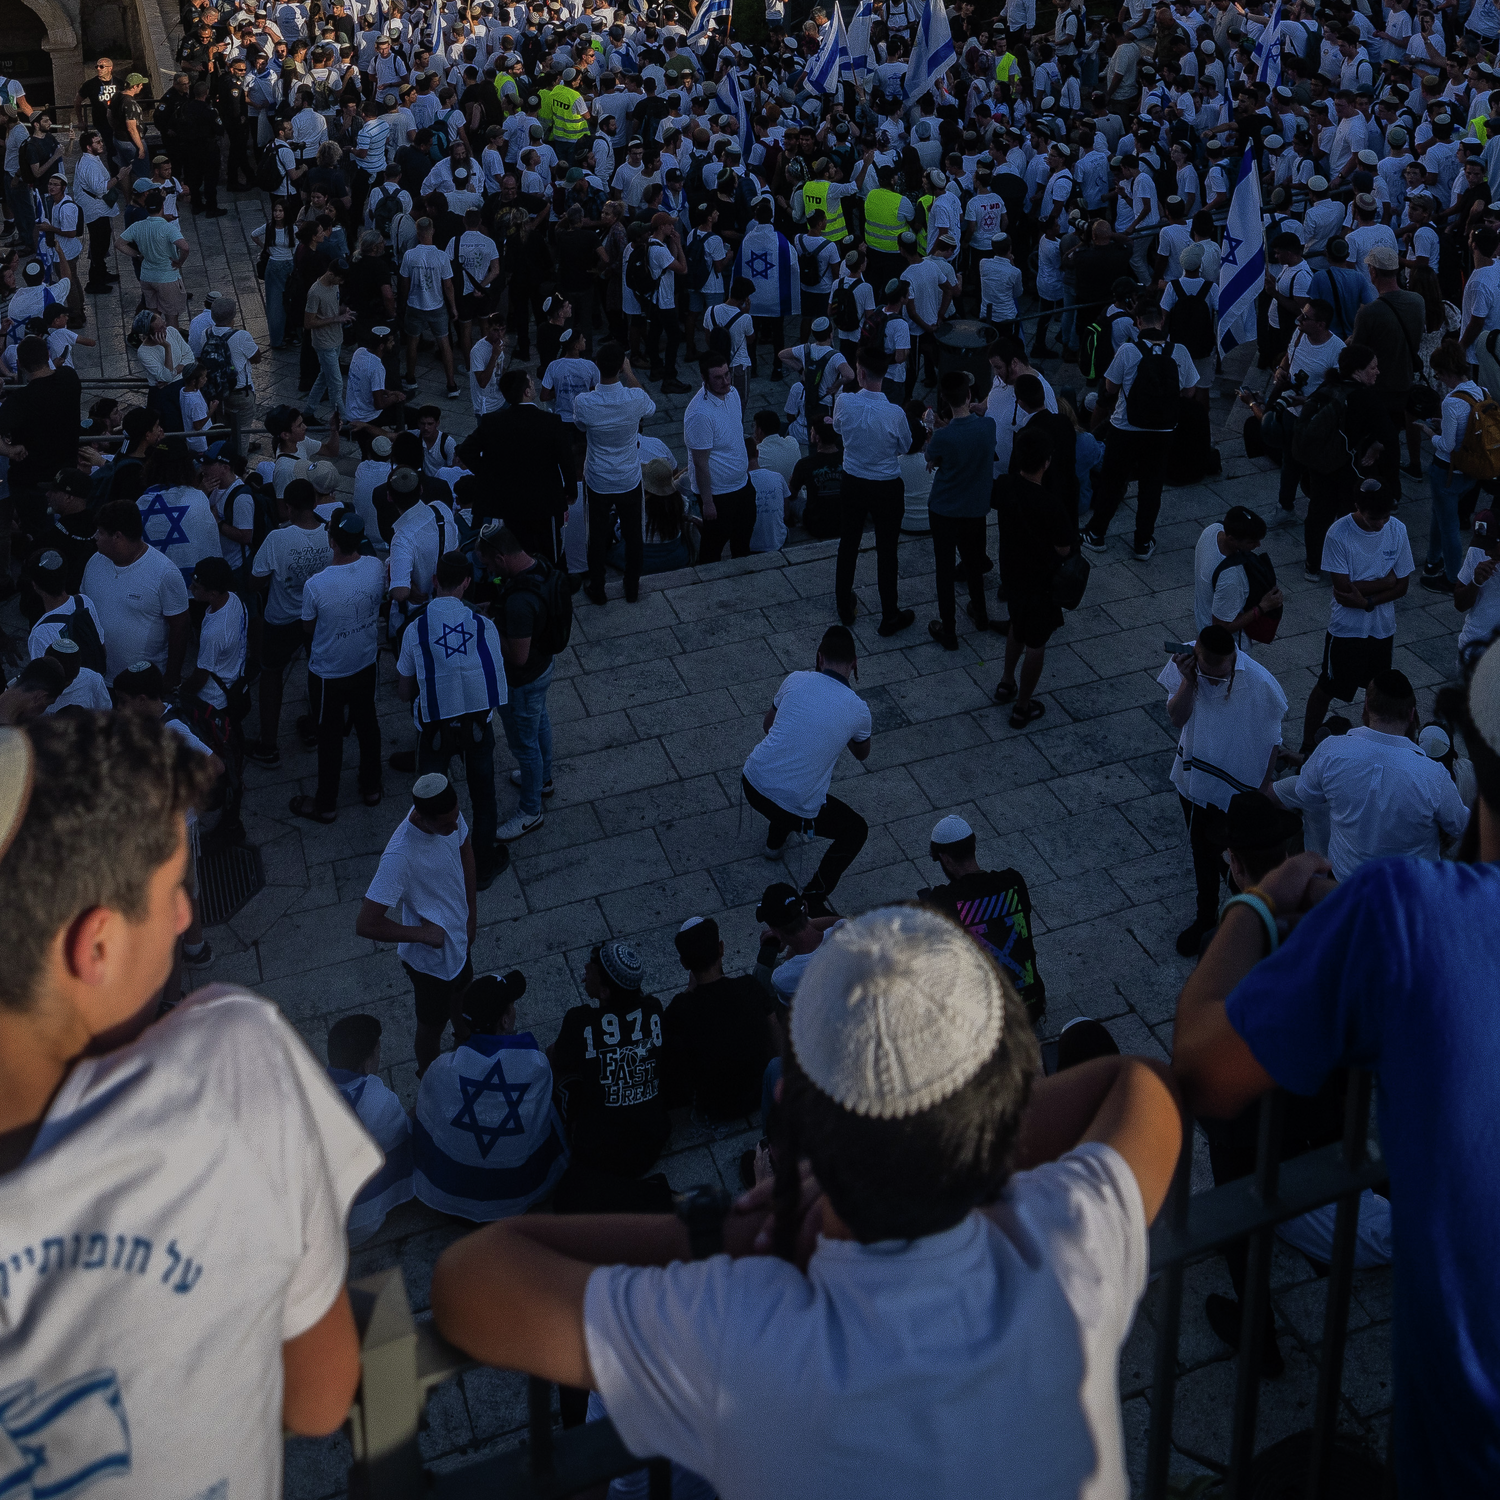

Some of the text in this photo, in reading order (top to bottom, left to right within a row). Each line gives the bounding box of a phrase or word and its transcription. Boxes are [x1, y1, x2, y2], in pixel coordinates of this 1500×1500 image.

[100, 85, 117, 95] JUST
[584, 1008, 663, 1060] 1978
[598, 1046, 657, 1086] FAST
[161, 1239, 203, 1294] על
